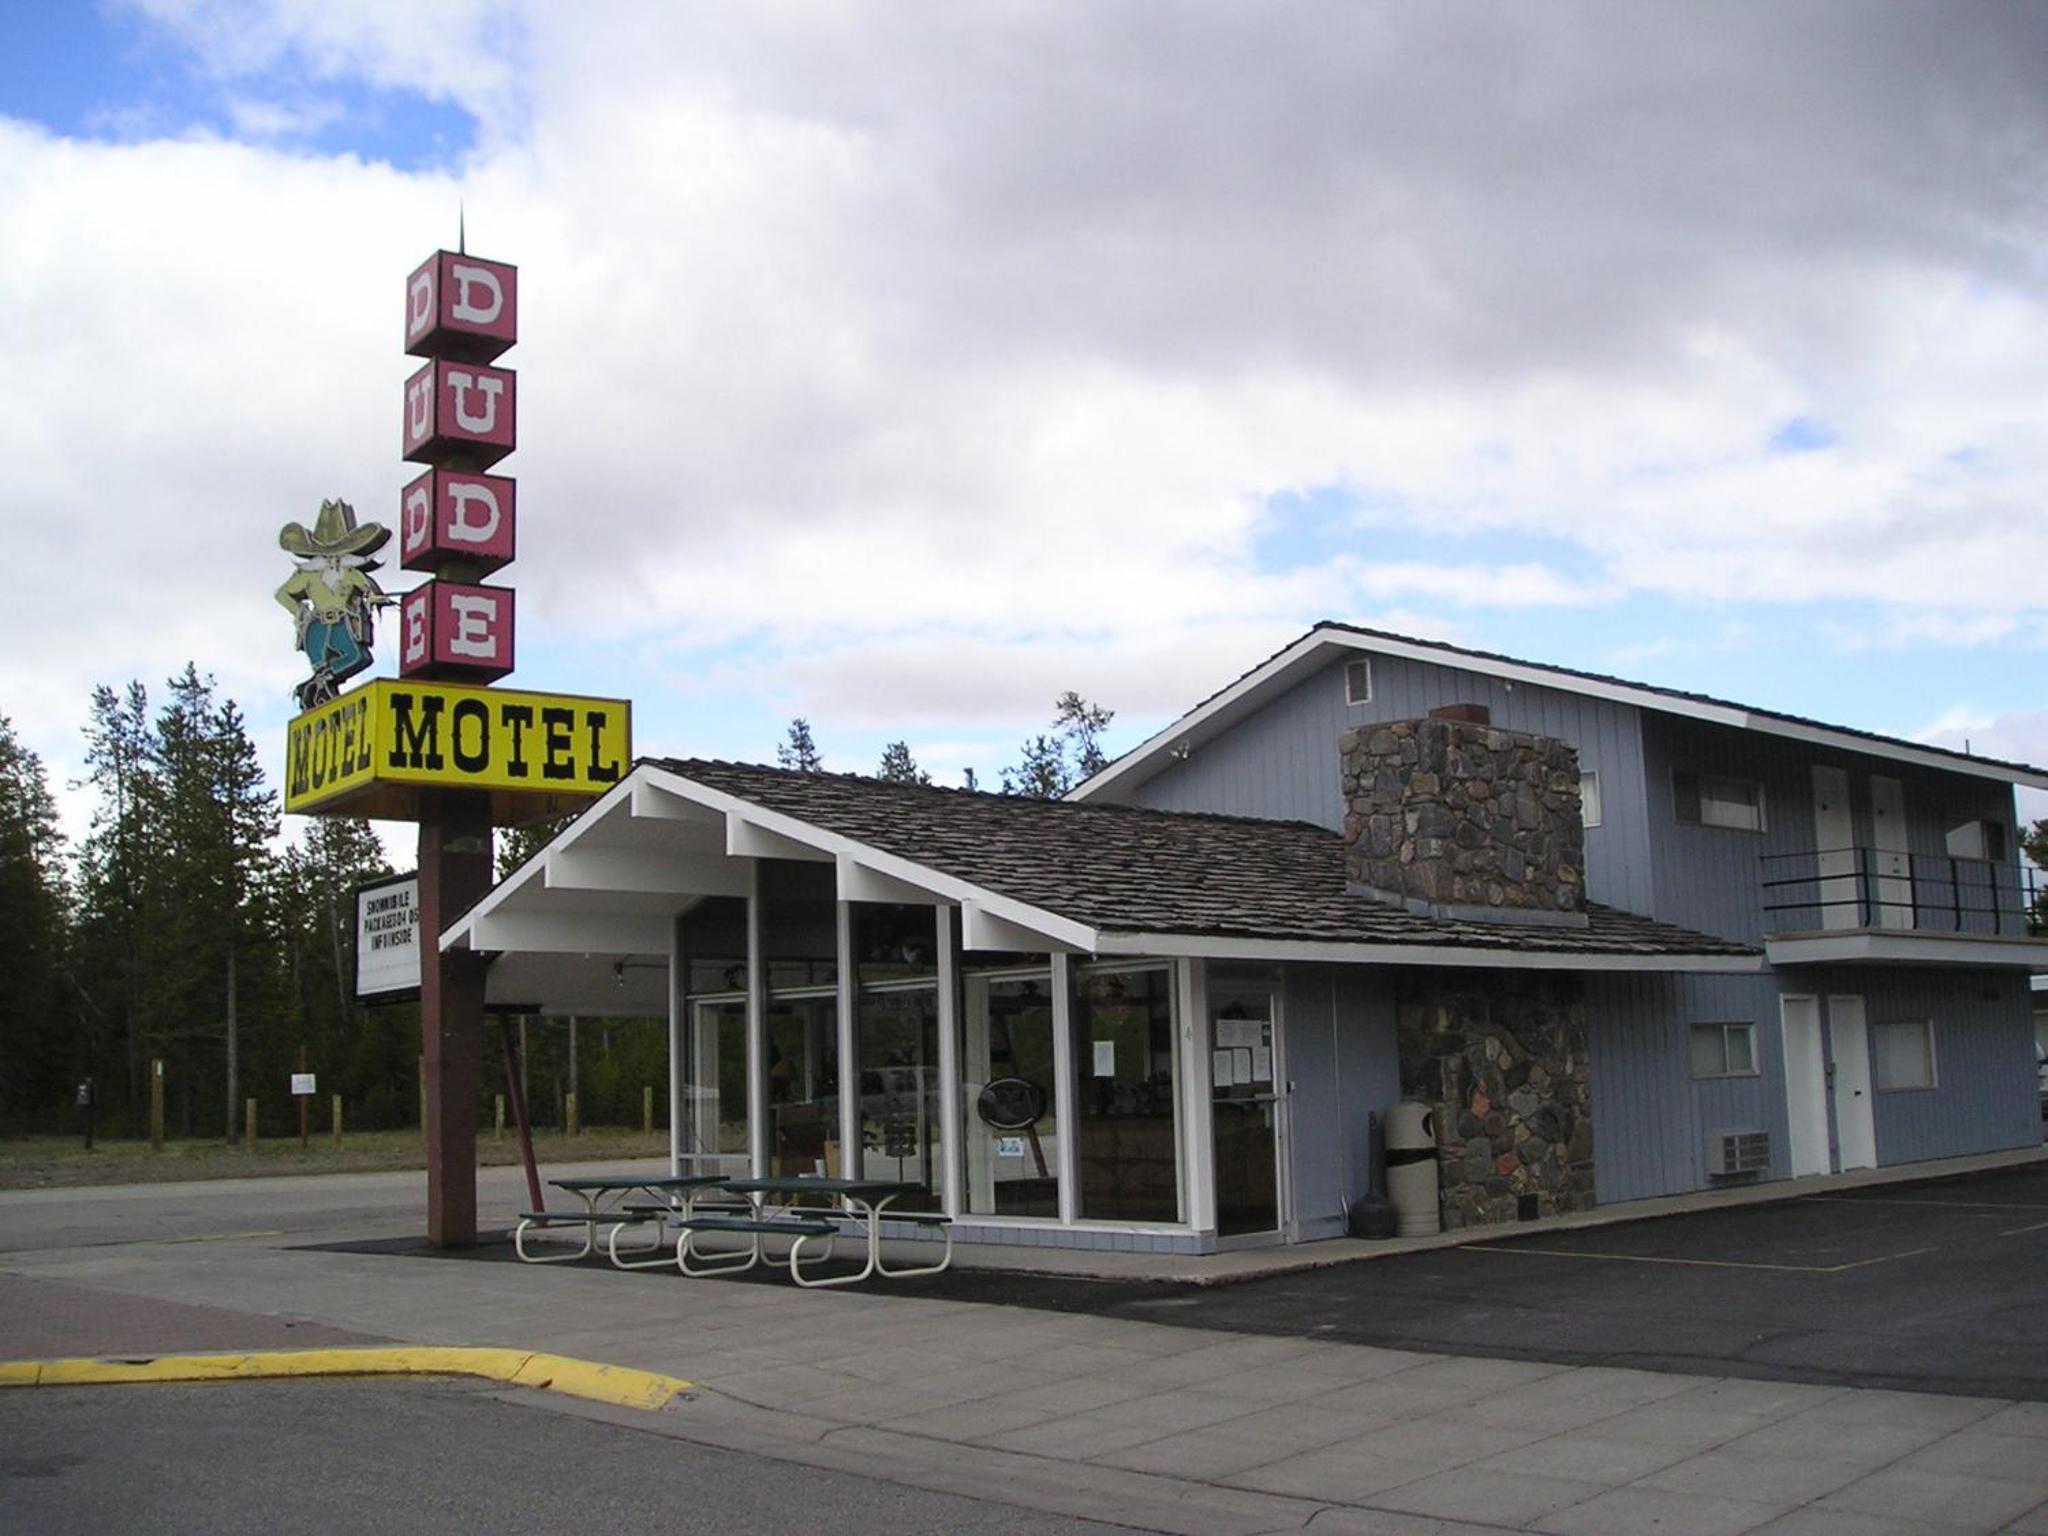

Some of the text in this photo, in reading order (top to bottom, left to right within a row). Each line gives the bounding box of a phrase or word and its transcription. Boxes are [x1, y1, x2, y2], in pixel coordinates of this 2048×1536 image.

[407, 271, 433, 664] DUDE
[447, 263, 504, 659] DUDE
[291, 696, 372, 798] MOTEL
[389, 692, 620, 782] MOTEL
